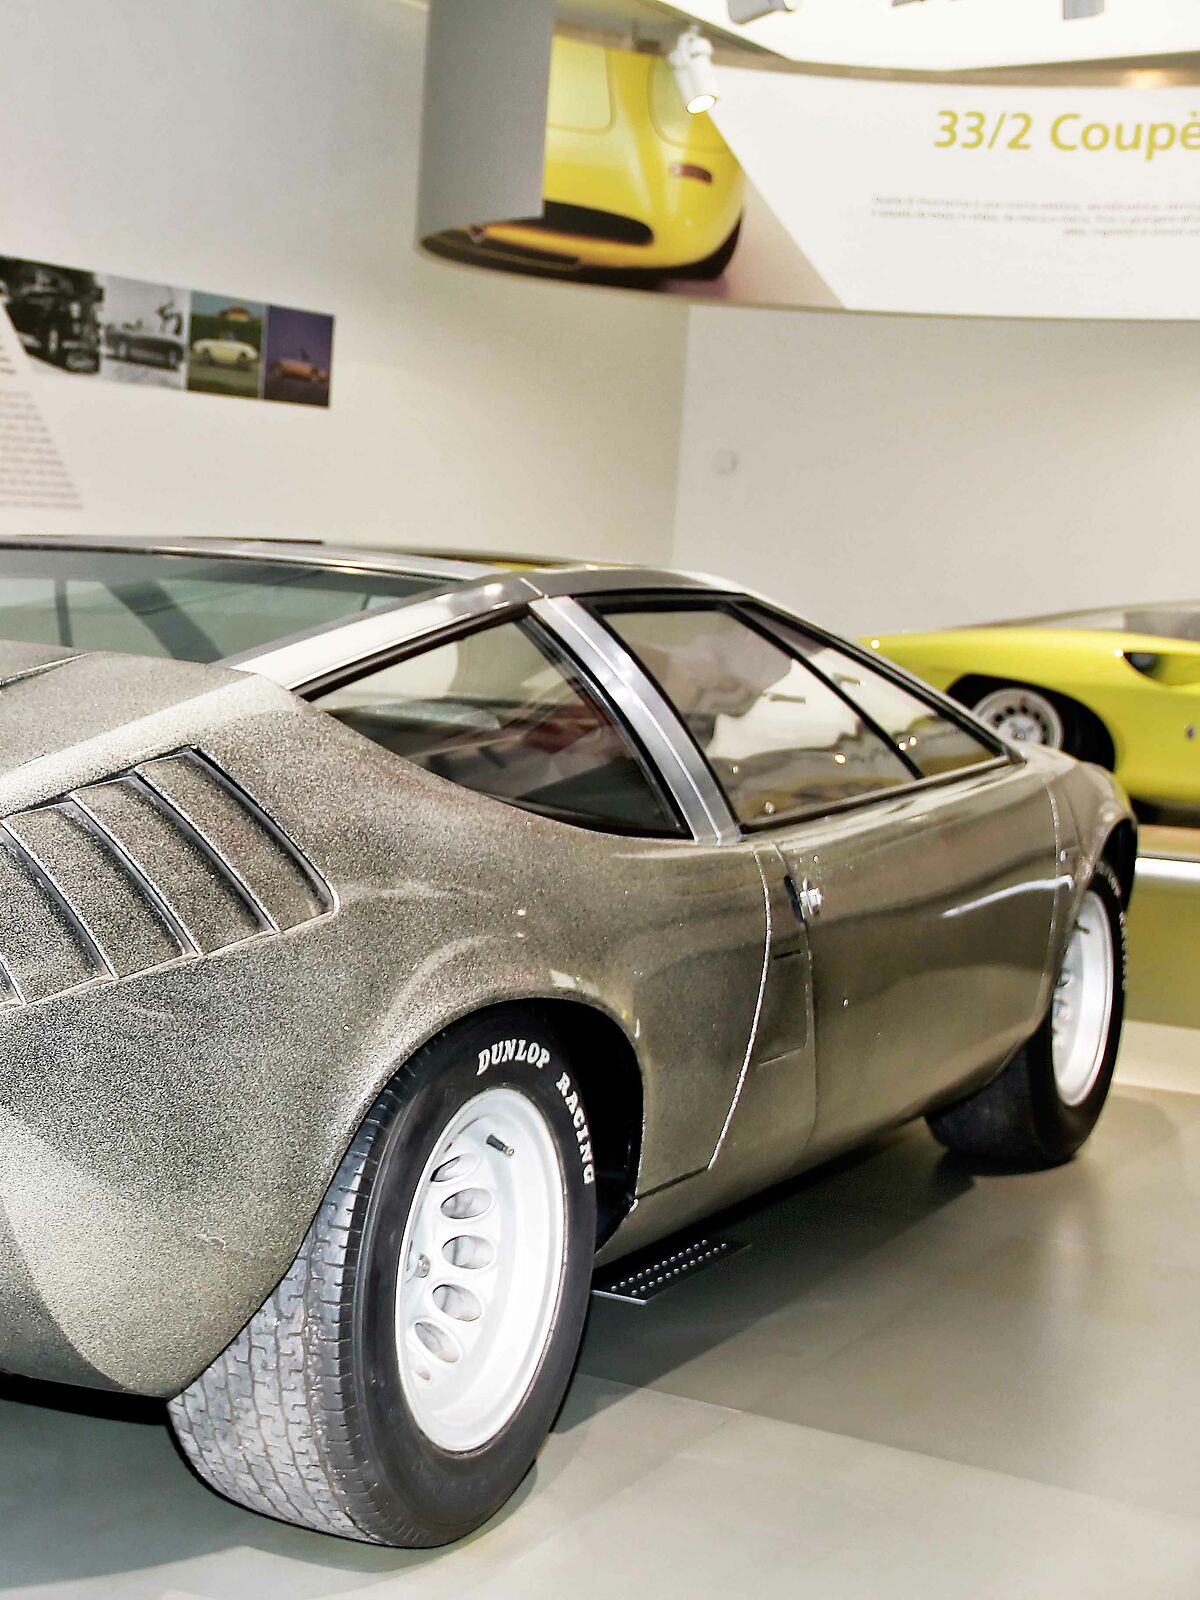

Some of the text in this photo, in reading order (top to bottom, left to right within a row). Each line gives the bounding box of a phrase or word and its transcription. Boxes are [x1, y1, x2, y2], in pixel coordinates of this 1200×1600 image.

[933, 109, 1032, 149] 33/2
[476, 1038, 596, 1185] DUNLOP RACING
